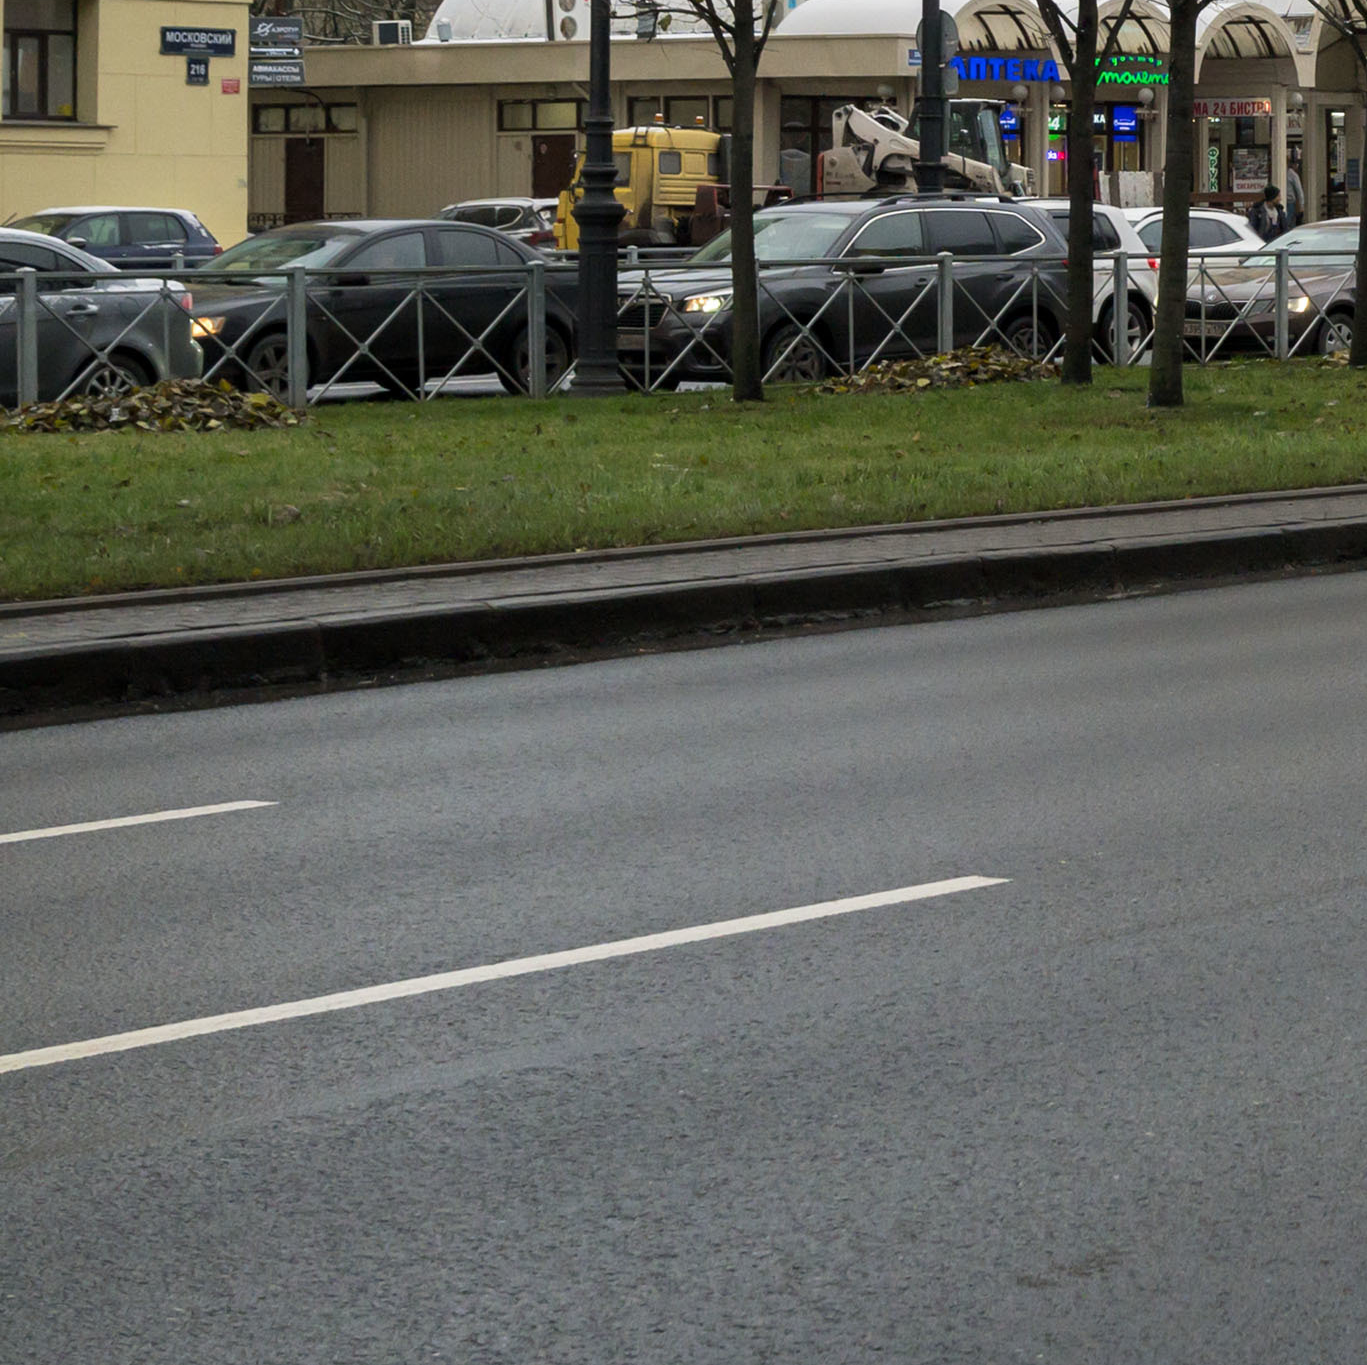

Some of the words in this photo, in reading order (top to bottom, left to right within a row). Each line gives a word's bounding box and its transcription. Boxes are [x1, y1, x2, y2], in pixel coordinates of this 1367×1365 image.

[165, 30, 233, 44] МОСКОВСКИЙ
[949, 56, 1061, 82] АПТЕКА
[1230, 100, 1271, 116] БИСТРО
